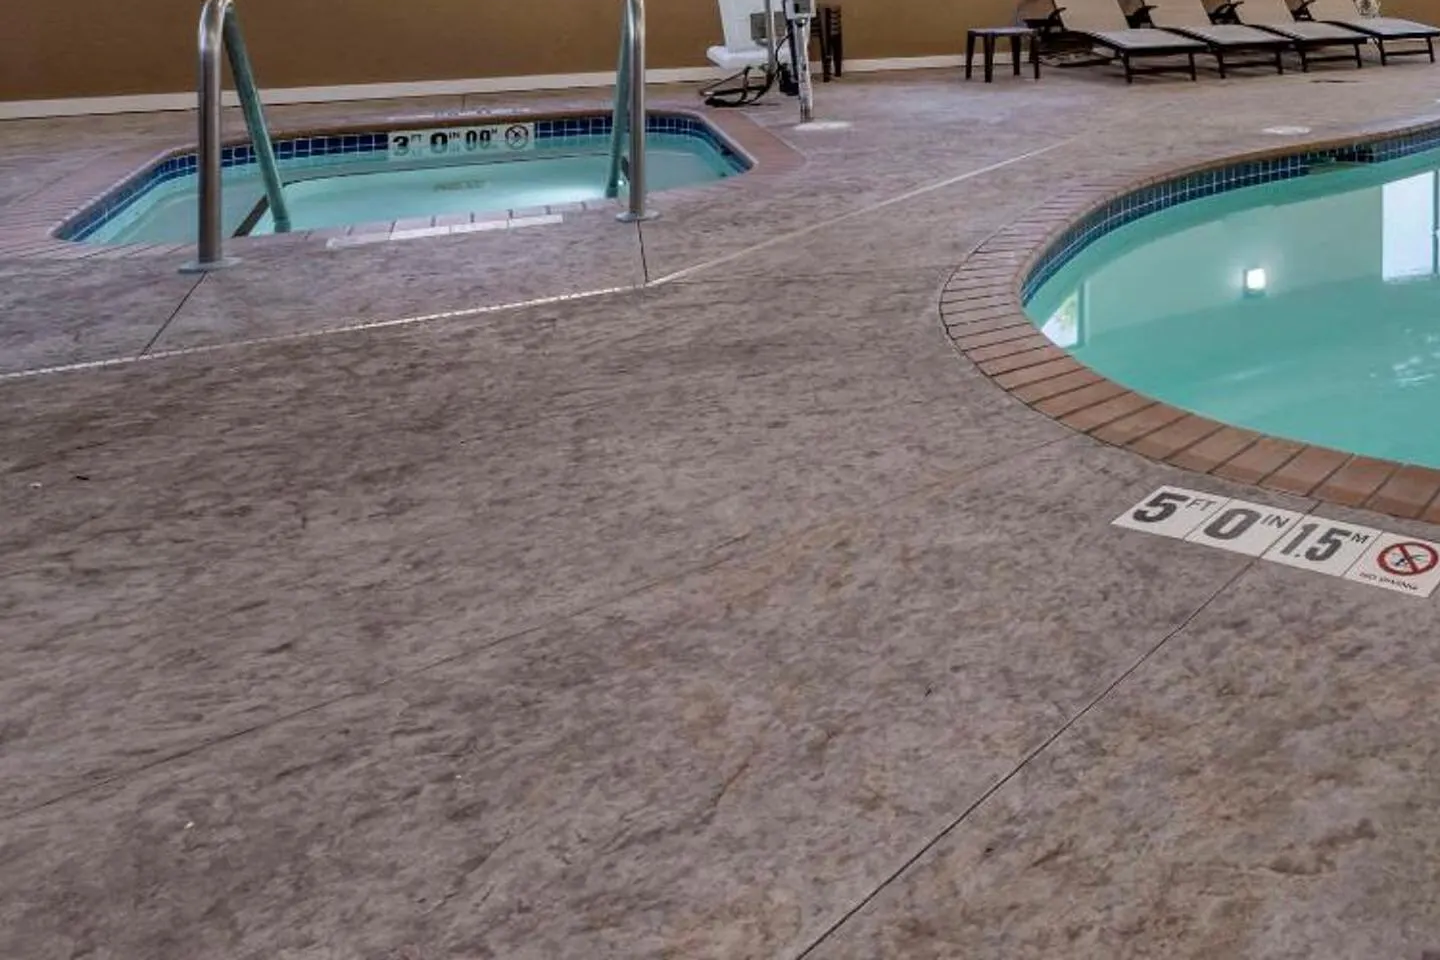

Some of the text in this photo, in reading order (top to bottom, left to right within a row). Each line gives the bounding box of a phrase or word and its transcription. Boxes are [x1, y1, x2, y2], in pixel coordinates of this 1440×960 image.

[1132, 492, 1189, 523] 5
[1185, 498, 1217, 511] FT
[1203, 508, 1262, 541] 0
[1261, 514, 1290, 529] IN
[1351, 532, 1370, 545] M
